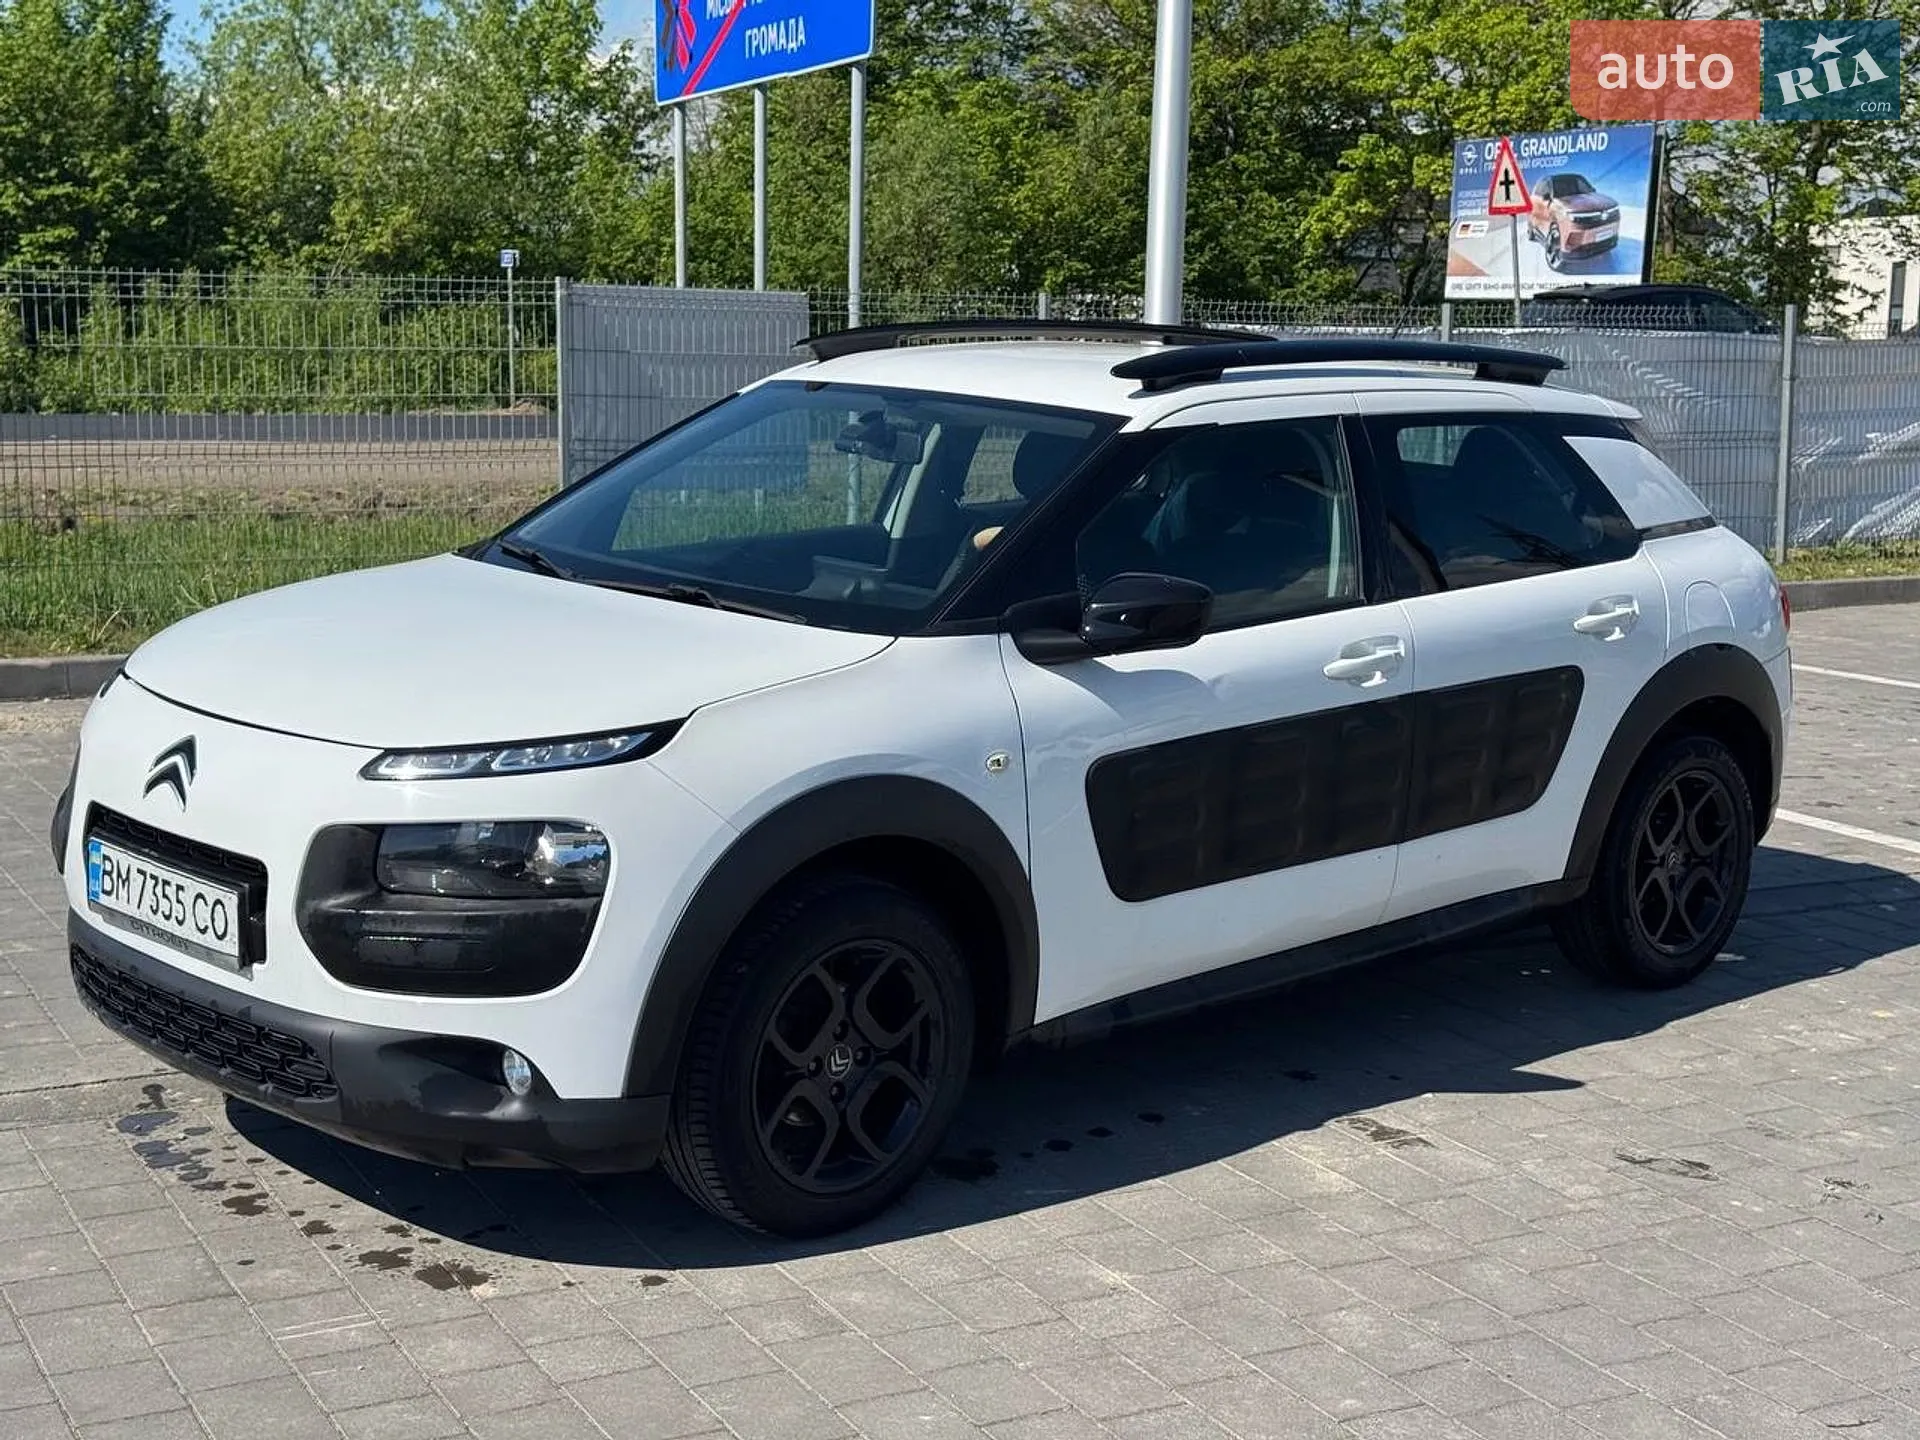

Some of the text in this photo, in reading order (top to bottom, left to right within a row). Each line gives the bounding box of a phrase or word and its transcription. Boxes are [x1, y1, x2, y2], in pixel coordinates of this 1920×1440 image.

[745, 15, 806, 59] ГРОМАДА
[1520, 132, 1608, 158] GRANDLAND
[102, 854, 228, 941] BM 7355 CO
